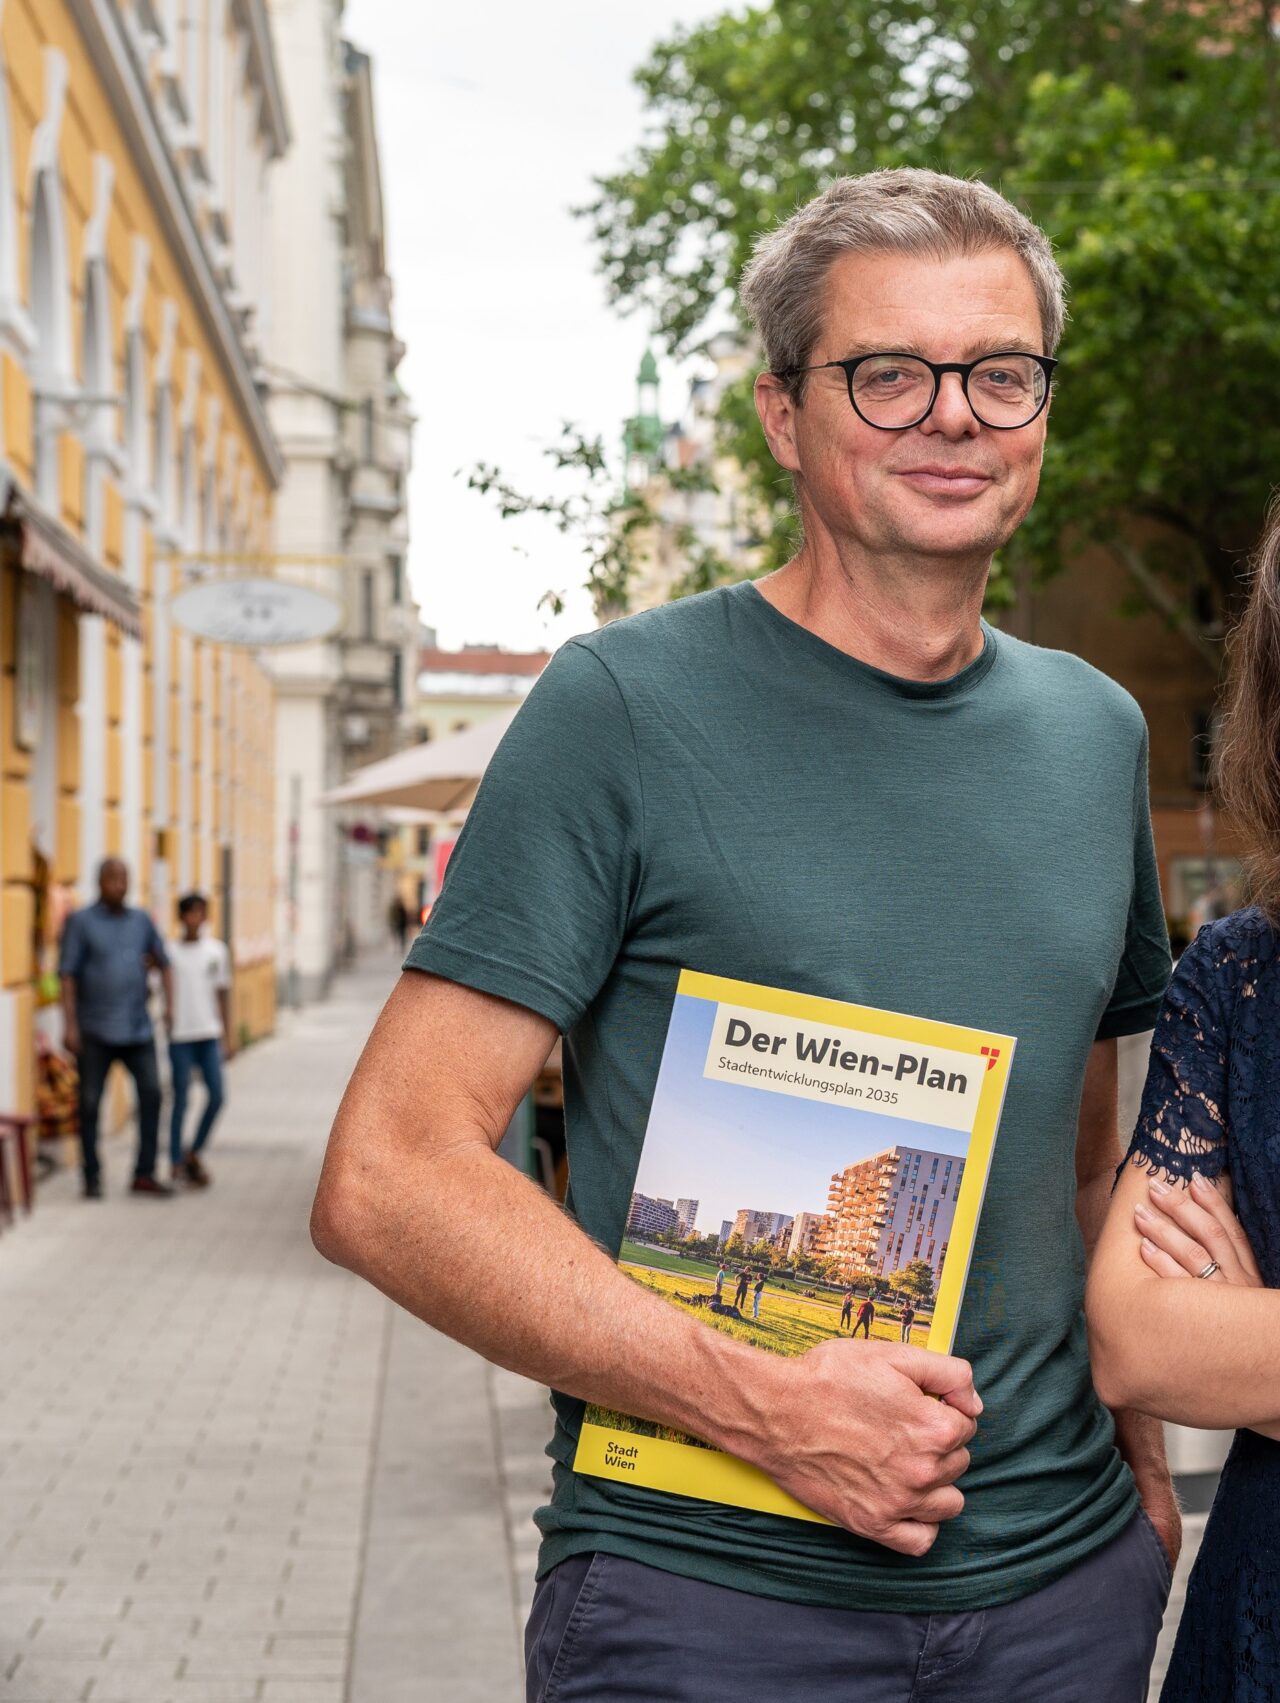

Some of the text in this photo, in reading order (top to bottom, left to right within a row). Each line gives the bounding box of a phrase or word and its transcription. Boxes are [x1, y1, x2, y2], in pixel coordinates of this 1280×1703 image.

[724, 1018, 968, 1094] Der Wien-Plan
[718, 1056, 899, 1104] Stadtentwicklungsplan 2035
[605, 1453, 636, 1471] Wien
[606, 1441, 639, 1458] Stadt
